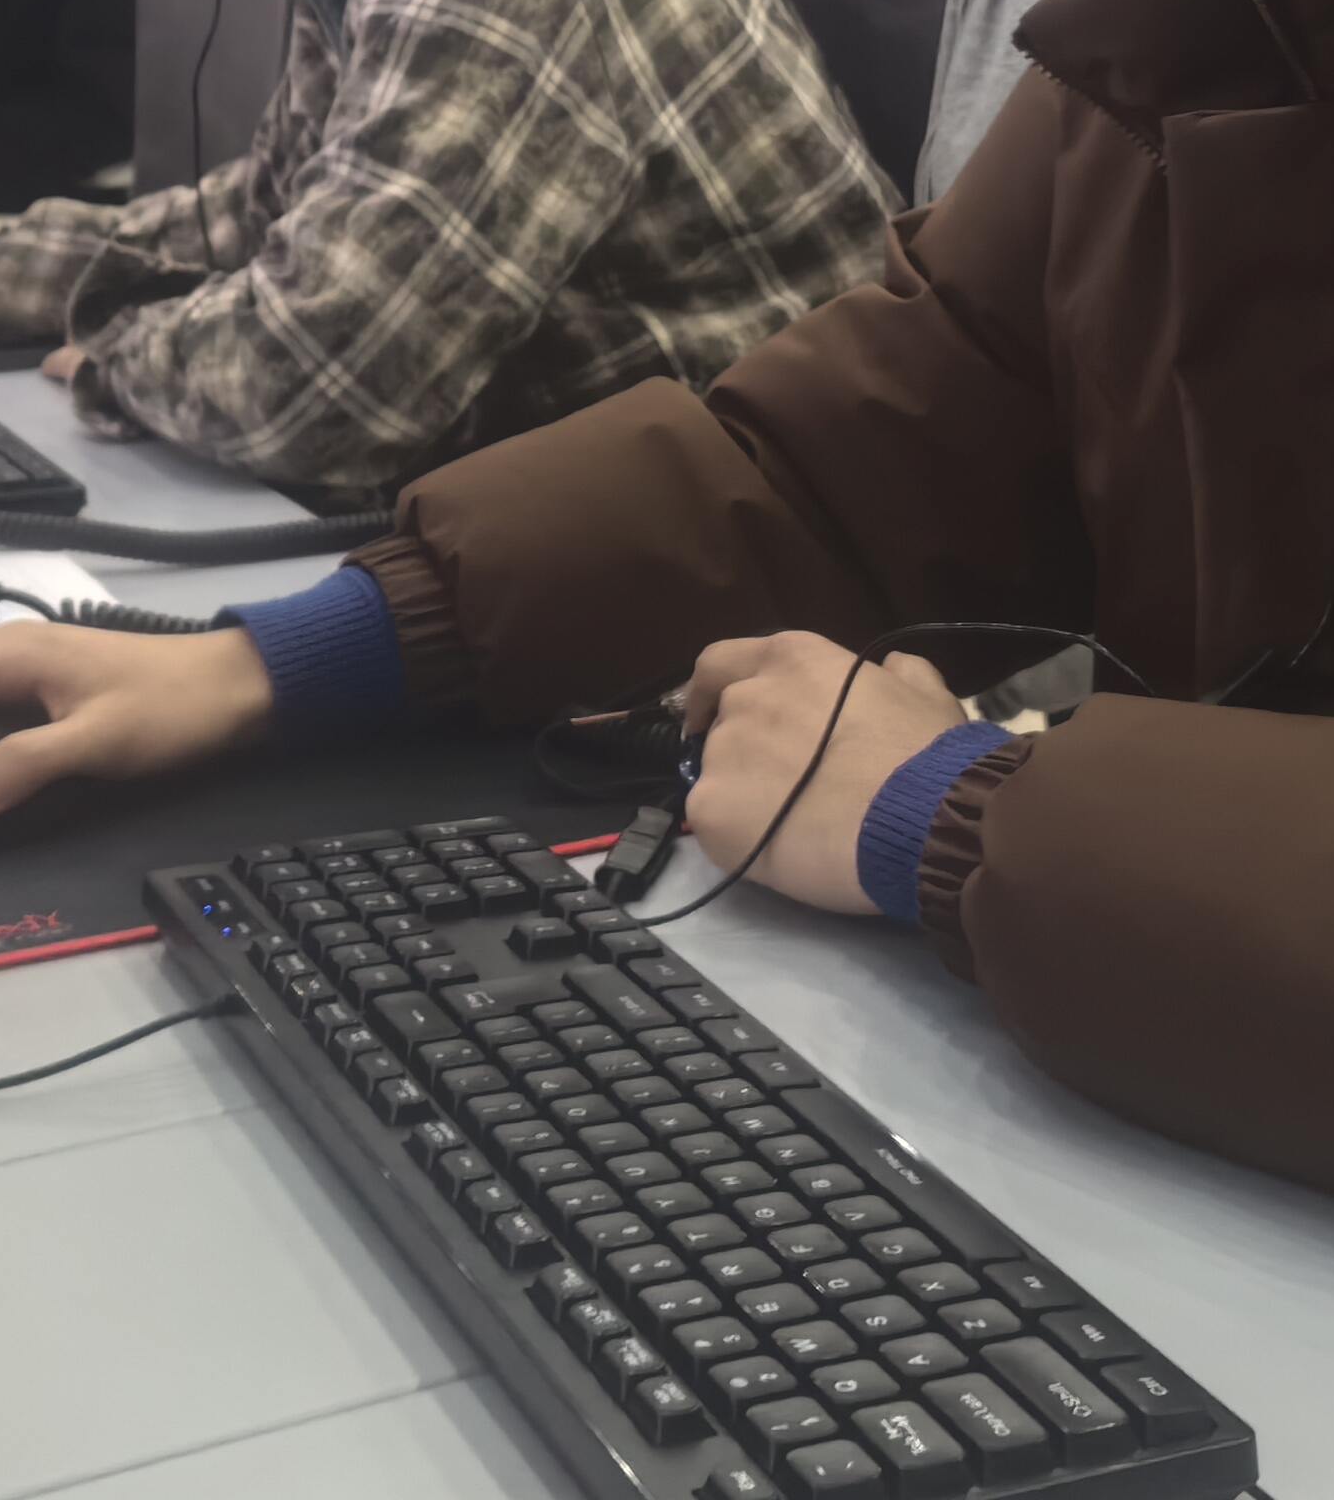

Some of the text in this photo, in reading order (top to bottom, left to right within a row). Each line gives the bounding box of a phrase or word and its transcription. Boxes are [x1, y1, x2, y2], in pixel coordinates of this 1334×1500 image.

[743, 1118, 764, 1129] M
[778, 1148, 796, 1158] N
[624, 1166, 646, 1177] U
[720, 1176, 740, 1186] H
[811, 1178, 832, 1189] B
[655, 1199, 675, 1208] Y
[754, 1207, 776, 1219] G
[845, 1212, 866, 1221] V
[687, 1232, 708, 1242] T
[790, 1244, 814, 1254] F
[882, 1244, 904, 1255] C
[720, 1264, 742, 1276] R
[827, 1277, 850, 1290] D
[922, 1281, 944, 1292] X
[755, 1301, 780, 1314] E
[865, 1315, 888, 1327] S
[962, 1318, 987, 1330] Z
[722, 1334, 741, 1343] 3
[790, 1338, 818, 1353] W
[907, 1353, 930, 1365] A
[834, 1379, 858, 1392] Q
[1138, 1376, 1169, 1397] Ctrl
